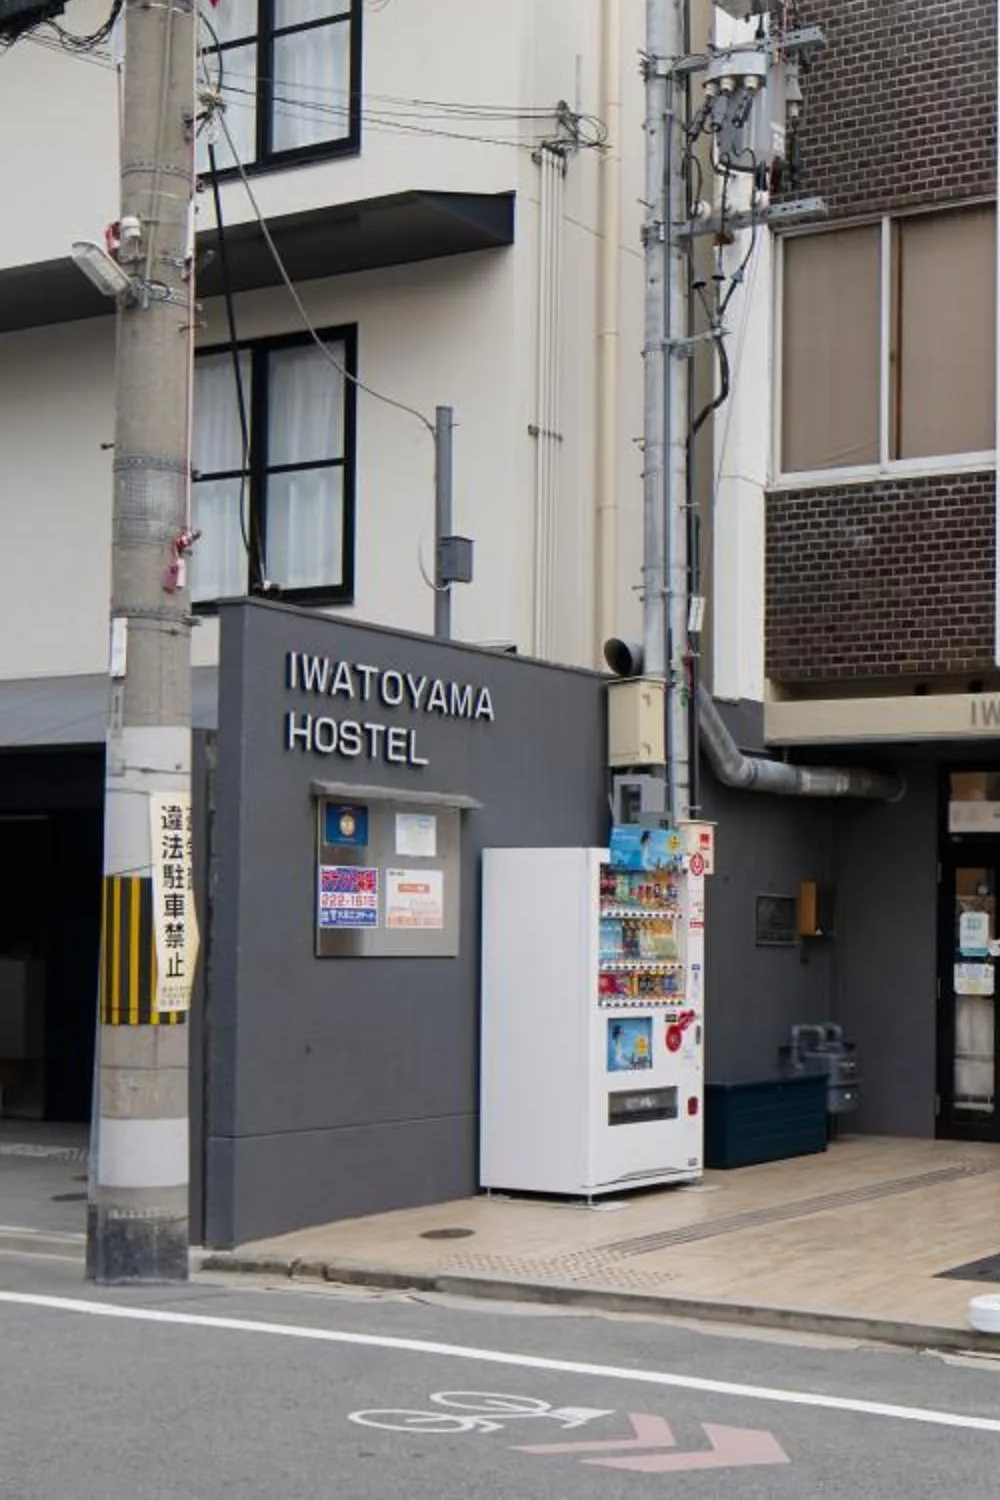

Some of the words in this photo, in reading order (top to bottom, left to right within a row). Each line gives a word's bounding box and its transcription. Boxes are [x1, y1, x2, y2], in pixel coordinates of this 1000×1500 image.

[287, 650, 495, 721] IWATOYAMA
[288, 710, 430, 765] HOSTEL
[161, 804, 185, 978] 違法駐車禁止
